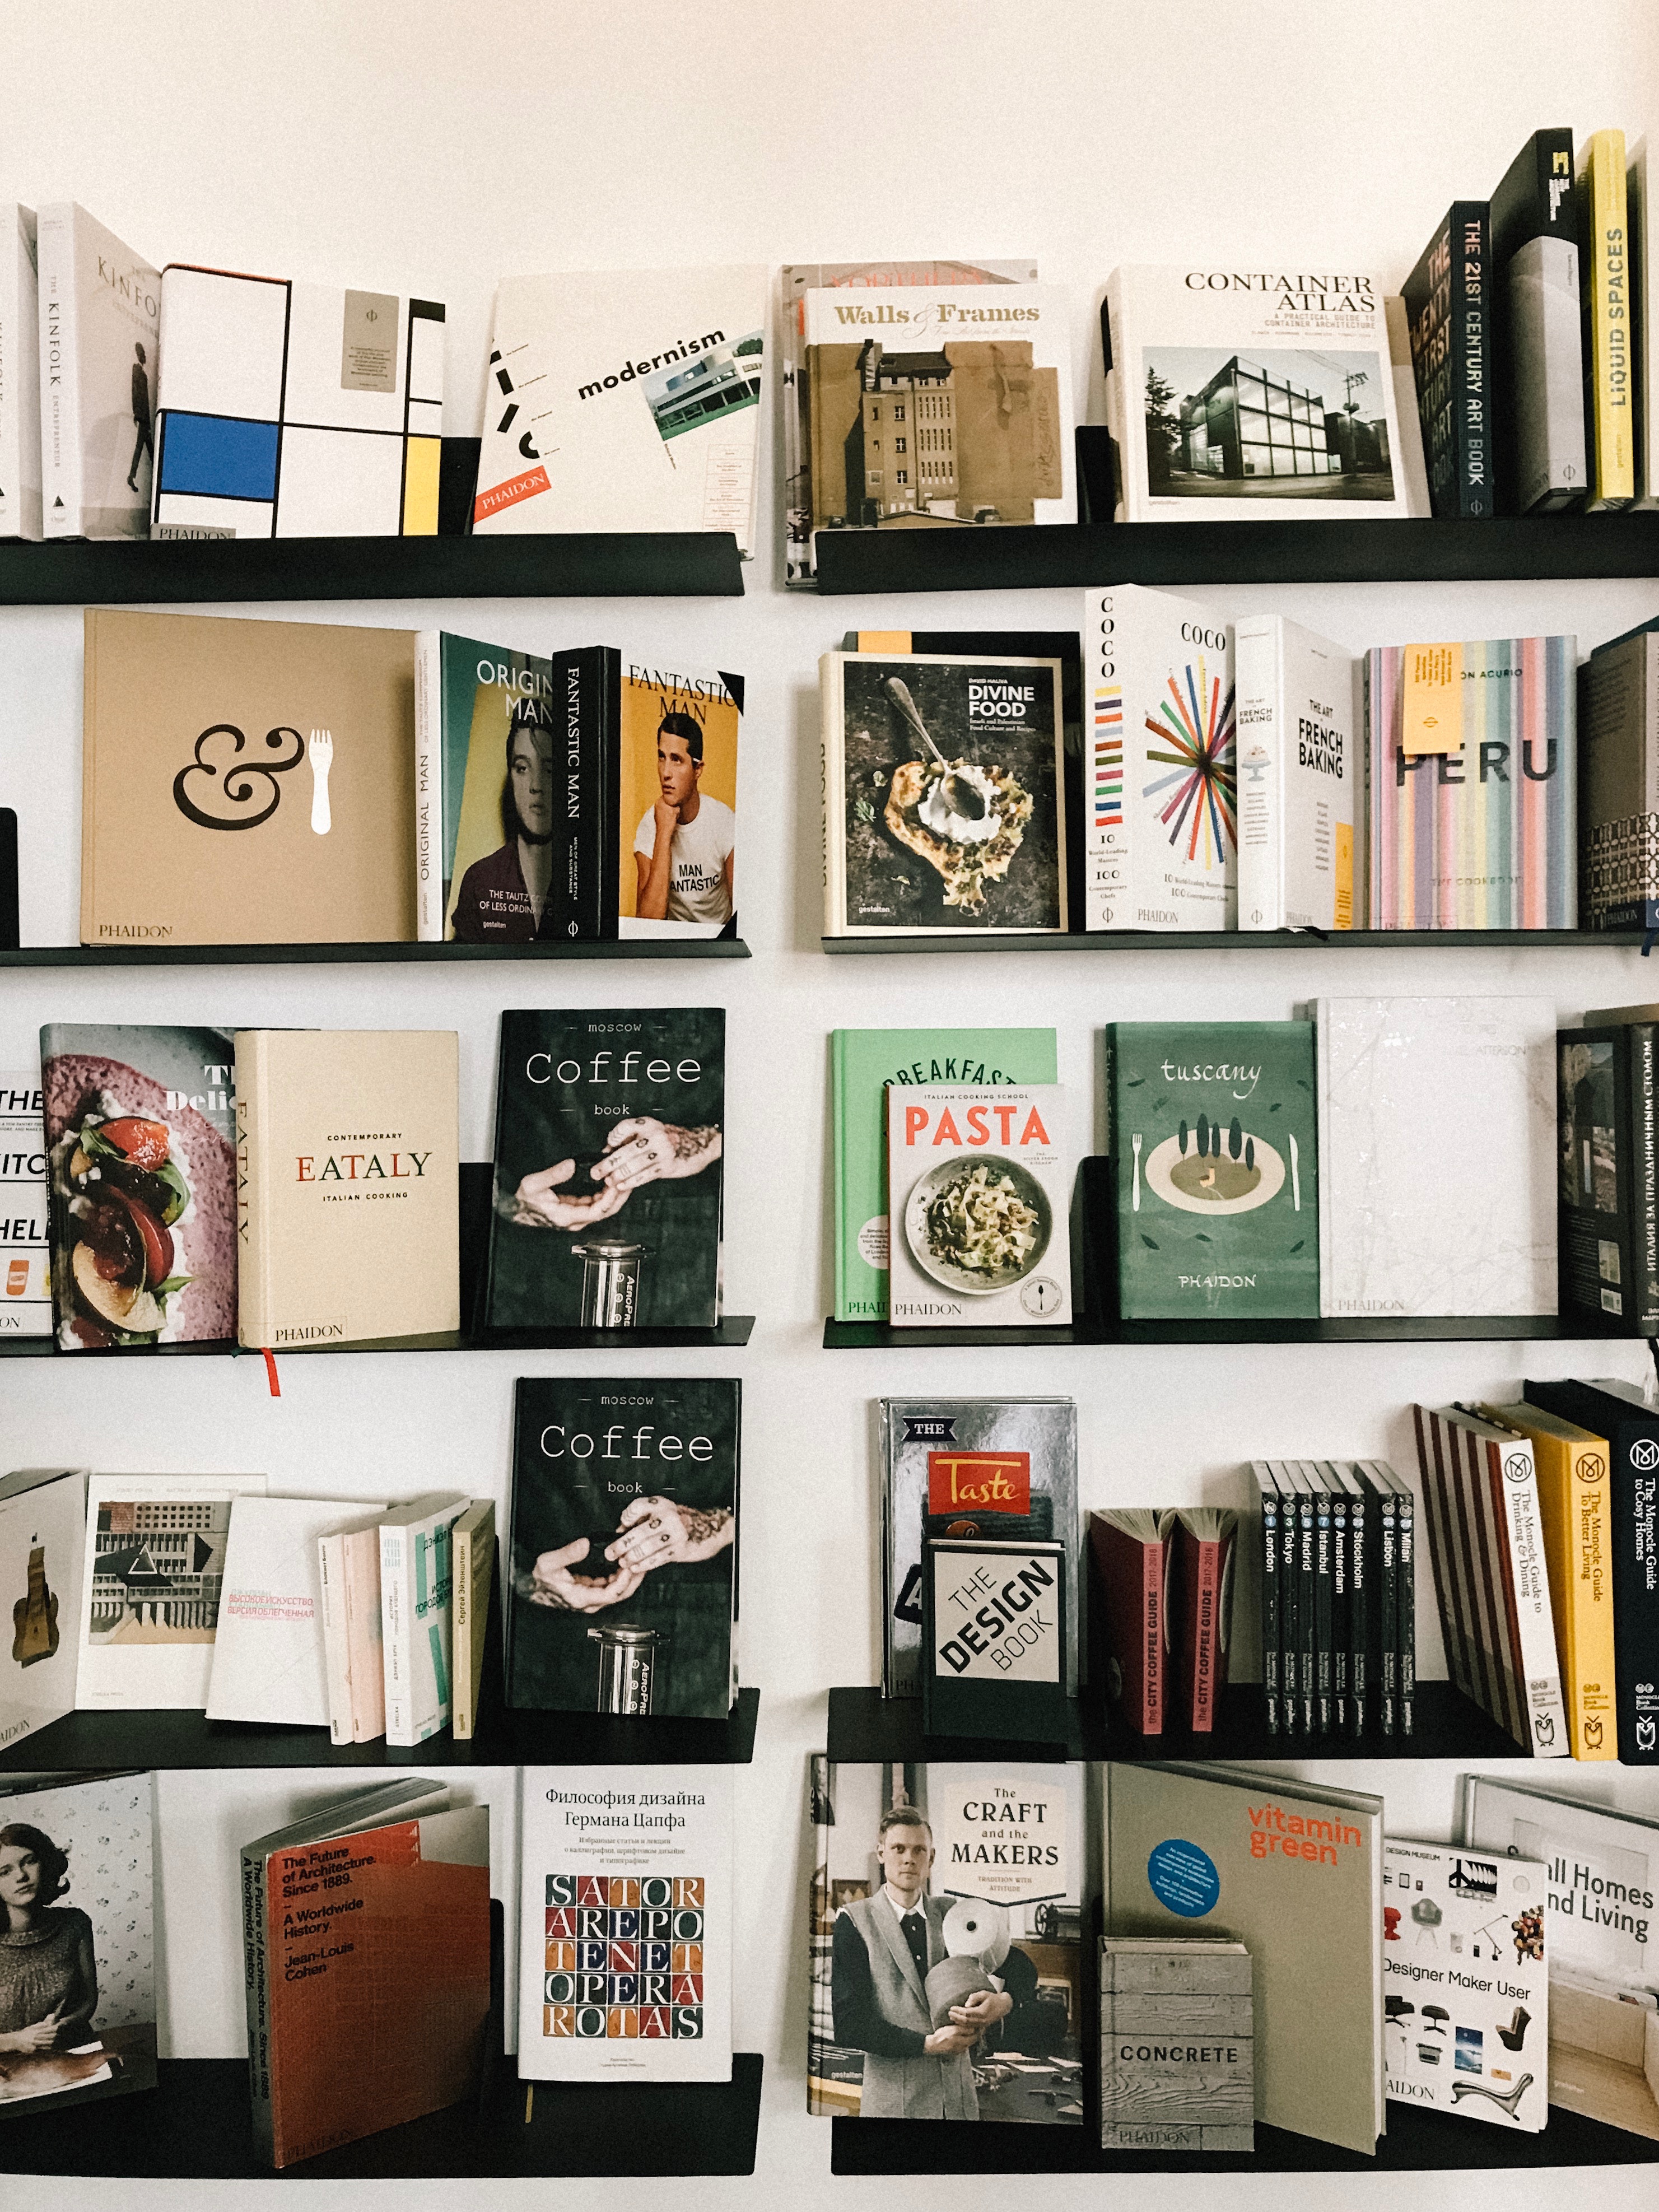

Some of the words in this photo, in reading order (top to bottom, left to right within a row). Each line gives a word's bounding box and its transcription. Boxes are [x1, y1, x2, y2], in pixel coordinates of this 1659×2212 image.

[1464, 220, 1481, 255] THE
[1185, 272, 1375, 294] CONTAINER
[1464, 260, 1481, 305] 21ST
[1606, 227, 1625, 319] SPACES
[835, 305, 910, 325] Walls
[937, 304, 1040, 323] Frames
[1276, 294, 1375, 312] ATLAS
[1316, 321, 1376, 329] ARCHITECTURE
[48, 303, 62, 386] KINFOLK
[1465, 311, 1484, 394] CENTURY
[577, 330, 726, 400] modernism
[1609, 328, 1627, 407] LIQUID
[1466, 398, 1483, 433] ART
[1467, 439, 1484, 486] BOOK
[482, 473, 546, 510] PHAIDON
[1181, 622, 1226, 651] COCO
[628, 664, 737, 707] FANTASTIC
[1479, 668, 1523, 679] ACURIO
[968, 684, 1035, 701] DIVINE
[567, 667, 580, 767] FANTASTIC
[659, 696, 707, 726] MAN
[969, 701, 1026, 717] FOOD
[1239, 707, 1273, 717] FRENCH
[1239, 714, 1273, 724] BAKING
[1298, 718, 1344, 755] FRENCH
[420, 755, 429, 792] MAN
[1299, 742, 1344, 779] BAKING
[567, 774, 580, 819] MAN
[420, 802, 429, 881] ORIGINAL
[678, 864, 702, 878] MAN
[479, 900, 490, 910] OF
[491, 902, 507, 912] LESS
[489, 890, 504, 900] THE
[505, 891, 530, 902] TAUTZ
[1138, 908, 1178, 923] PHAIDON
[98, 925, 173, 938] PHAIDON
[588, 1023, 642, 1033] moscow
[526, 1051, 701, 1084] Coffee
[1161, 1059, 1261, 1099] tuscany
[1643, 1040, 1652, 1096] СТОЛОМ
[594, 1103, 631, 1115] book
[327, 1133, 403, 1142] CONTEMPORARY
[906, 1105, 1051, 1146] PASTA
[1644, 1099, 1656, 1201] ПРАЗДНИЧНЫМ
[295, 1152, 433, 1182] EATALY
[366, 1192, 409, 1200] COOKING
[1646, 1205, 1656, 1219] ЗА
[1647, 1222, 1656, 1272] ИТАЛИЯ
[1178, 1274, 1257, 1288] PHAIDON
[894, 1303, 962, 1315] PHAIDON
[1338, 1300, 1405, 1311] PHAIDON
[275, 1324, 343, 1342] PHAIDON
[600, 1394, 654, 1406] moscow
[540, 1425, 714, 1461] Coffee
[914, 1423, 944, 1435] THE
[608, 1481, 644, 1493] book
[934, 1458, 1022, 1503] Taste
[1634, 1479, 1644, 1489] to
[1645, 1478, 1656, 1502] The
[1522, 1490, 1530, 1512] The
[1581, 1492, 1591, 1506] To
[1591, 1491, 1601, 1514] The
[1634, 1491, 1645, 1520] Cosy
[1525, 1516, 1537, 1563] Monocle
[1582, 1509, 1591, 1542] Better
[1592, 1517, 1602, 1565] Monocle
[1646, 1504, 1657, 1553] Monocle
[1265, 1530, 1274, 1572] London
[1283, 1531, 1294, 1564] Tokyo
[1302, 1531, 1312, 1571] Madrid
[1318, 1530, 1329, 1575] Istanbul
[1382, 1530, 1392, 1567] Lisbon
[1400, 1532, 1410, 1563] Milan
[1512, 1493, 1523, 1542] Drinking
[1520, 1559, 1530, 1598] Dining
[1635, 1522, 1646, 1562] Homes
[457, 1545, 465, 1595] Эйзенштейн
[1335, 1530, 1344, 1594] Amsterdam
[1353, 1530, 1363, 1589] Stockholm
[1581, 1545, 1592, 1580] Living
[1646, 1556, 1657, 1590] Guide
[948, 1566, 997, 1611] THE
[1530, 1566, 1542, 1599] Guide
[1593, 1568, 1604, 1601] Guide
[227, 1606, 257, 1615] ВЕРСИЯ
[258, 1608, 314, 1617] ОБЛЕГЧЕННАЯ
[229, 1594, 265, 1604] ВЫСОКОЕ
[266, 1596, 314, 1606] ИСКУССТВО
[458, 1596, 466, 1625] Сергей
[1148, 1591, 1158, 1629] GUIDE
[1202, 1589, 1212, 1628] GUIDE
[1535, 1603, 1542, 1613] to
[938, 1558, 1055, 1674] DESIGN
[990, 1609, 1054, 1671] BOOK
[1199, 1629, 1210, 1682] COFFEE
[1148, 1631, 1158, 1684] COFFEE
[1148, 1685, 1158, 1708] CITY
[1199, 1683, 1208, 1705] CITY
[1148, 1709, 1158, 1724] the
[1198, 1707, 1206, 1722] the
[546, 1789, 635, 1809] Философия
[639, 1791, 706, 1808] дизайна
[994, 1787, 1017, 1799] The
[565, 1811, 630, 1831] Германа
[633, 1812, 686, 1832] Цапфа
[963, 1802, 1047, 1823] CRAFT
[1248, 1803, 1362, 1847] vitamin
[981, 1828, 1004, 1840] and
[1009, 1828, 1029, 1839] the
[1250, 1830, 1337, 1866] green
[282, 1872, 297, 1884] of
[299, 1854, 376, 1880] Architecture.
[283, 1856, 307, 1869] The
[310, 1847, 350, 1866] Future
[950, 1843, 1059, 1866] MAKERS
[1385, 1847, 1411, 1857] DESIGN
[1412, 1850, 1441, 1861] MUSEUM
[254, 1860, 263, 1883] The
[283, 1881, 319, 1898] Since
[321, 1875, 353, 1890] 1889.
[1574, 1863, 1653, 1909] Homes
[244, 1869, 255, 1939] Worldwide
[254, 1887, 264, 1927] Future
[549, 1875, 702, 1908] SATOR
[283, 1913, 293, 1927] A
[296, 1897, 364, 1924] Worldwide
[547, 1908, 703, 1939] AREPO
[1582, 1894, 1649, 1943] Living
[255, 1931, 264, 1945] of
[283, 1921, 332, 1939] History.
[245, 1941, 256, 1991] History.
[283, 1940, 355, 1969] Jean-Louis
[547, 1940, 702, 1972] TENET
[256, 1947, 266, 2028] Architecture.
[285, 1962, 327, 1982] Cohen
[1448, 1970, 1492, 1993] Maker
[1497, 1981, 1531, 2000] User
[546, 1973, 702, 2005] OPERA
[548, 2006, 700, 2038] ROTAS
[259, 2031, 268, 2068] Since
[1120, 2045, 1238, 2064] CONCRETE
[1120, 2130, 1191, 2144] PHAIDON
